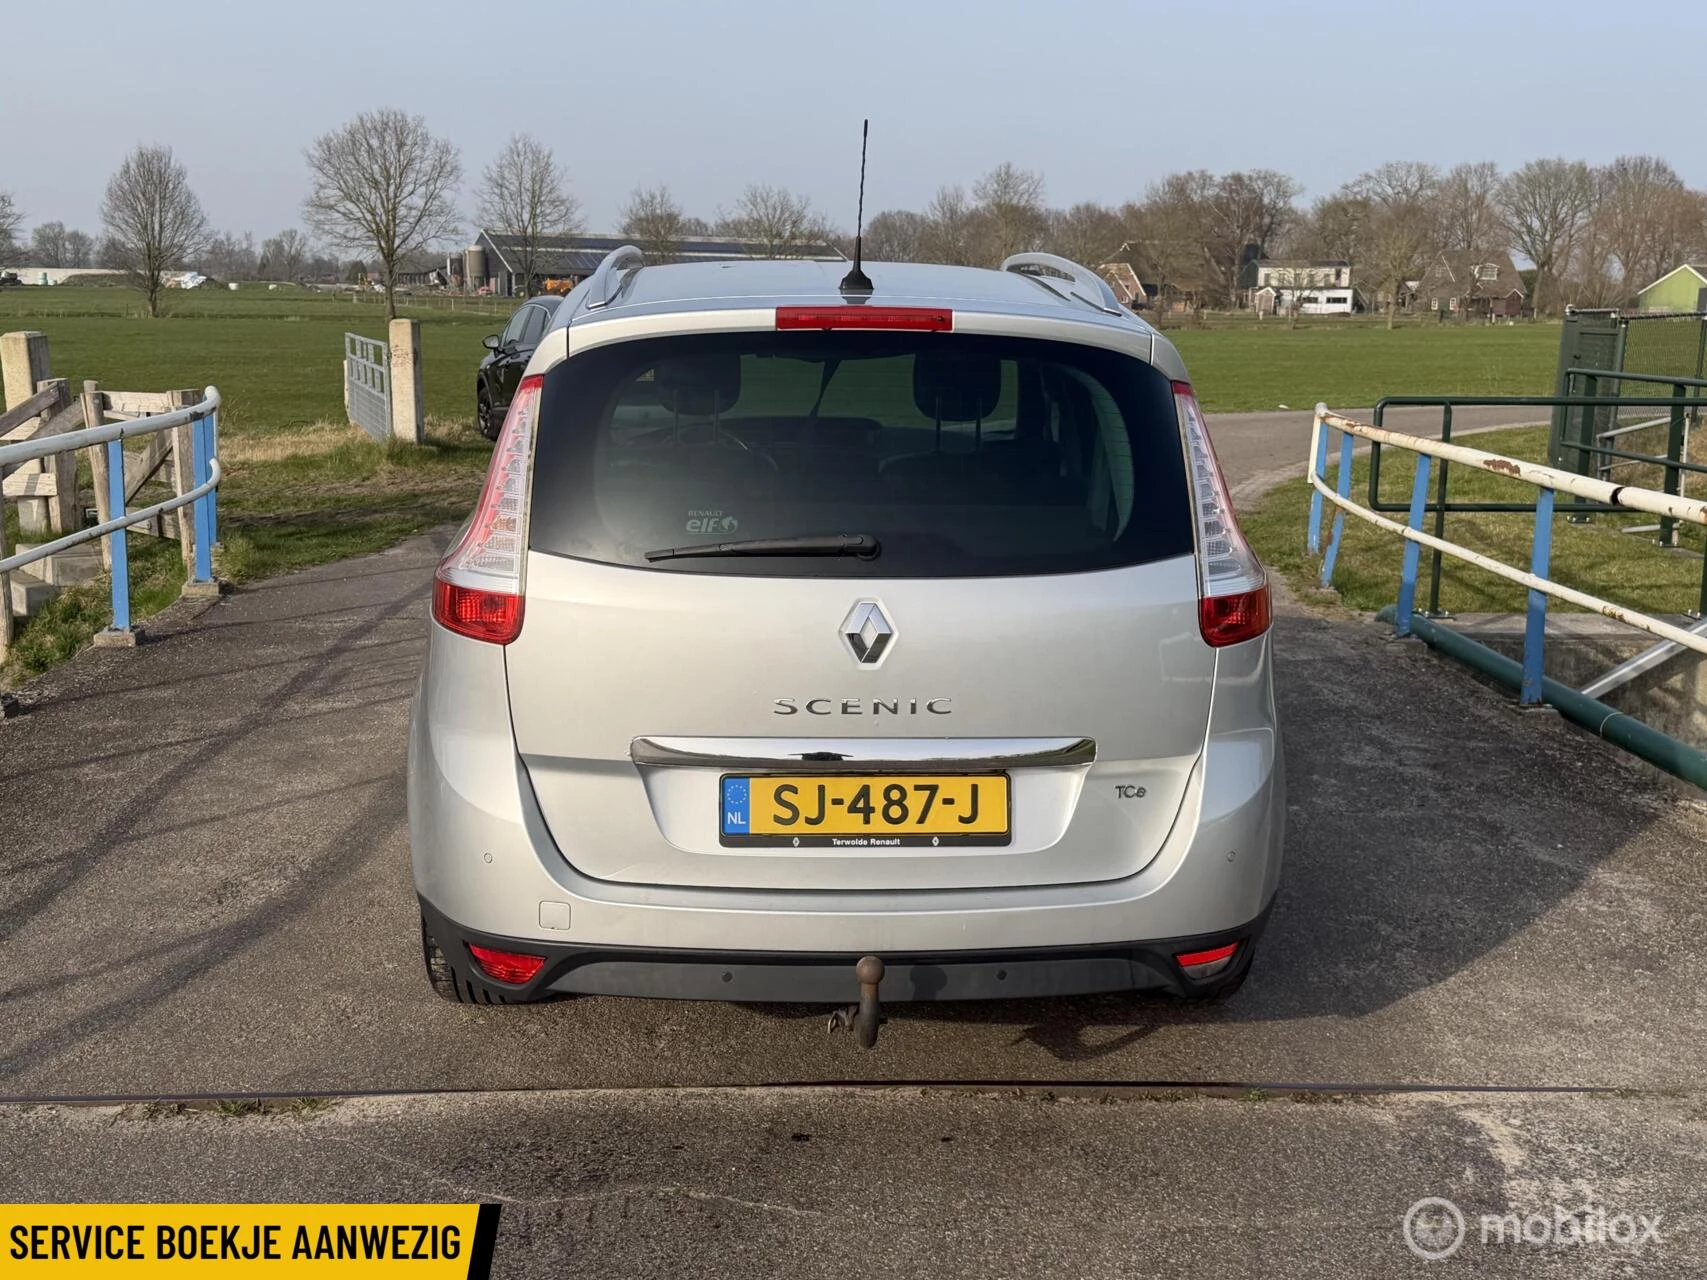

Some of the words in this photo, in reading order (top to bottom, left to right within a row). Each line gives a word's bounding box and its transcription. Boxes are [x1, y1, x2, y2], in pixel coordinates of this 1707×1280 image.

[773, 697, 952, 715] SCENIC
[1115, 785, 1146, 799] TCe
[773, 783, 979, 825] SJ-487-J
[727, 811, 746, 825] NL
[832, 838, 868, 846] Terwolde
[870, 838, 900, 846] Renault
